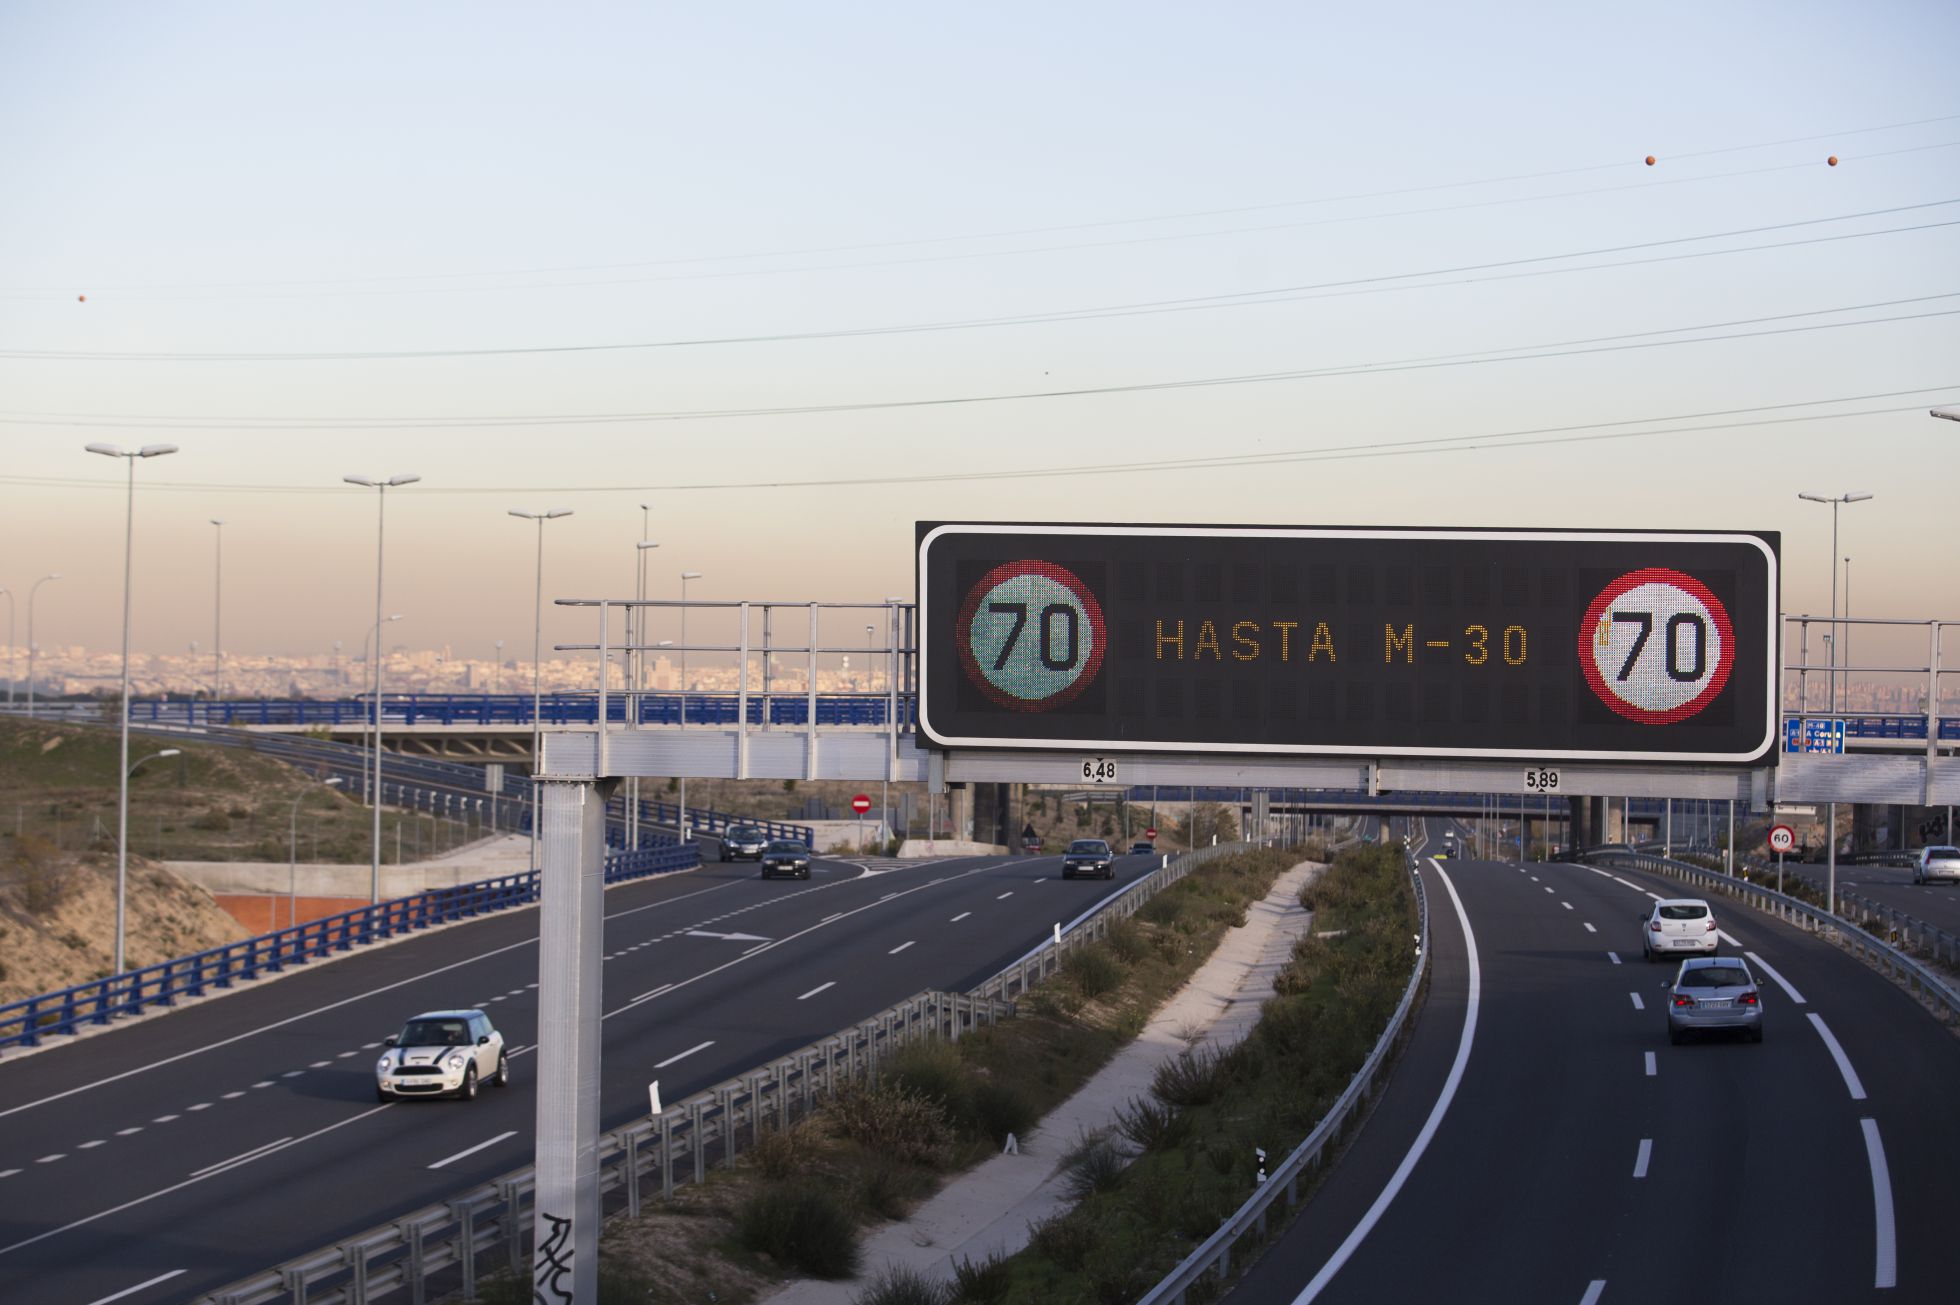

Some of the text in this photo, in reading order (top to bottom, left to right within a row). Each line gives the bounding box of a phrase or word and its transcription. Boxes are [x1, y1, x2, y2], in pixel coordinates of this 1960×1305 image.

[988, 603, 1078, 671] 70
[1156, 620, 1527, 665] HASTA M-30
[1612, 612, 1706, 682] 70
[1814, 730, 1841, 738] Corua
[1083, 762, 1115, 778] 6,48
[1527, 772, 1558, 788] 5,89
[1774, 834, 1789, 843] 60
